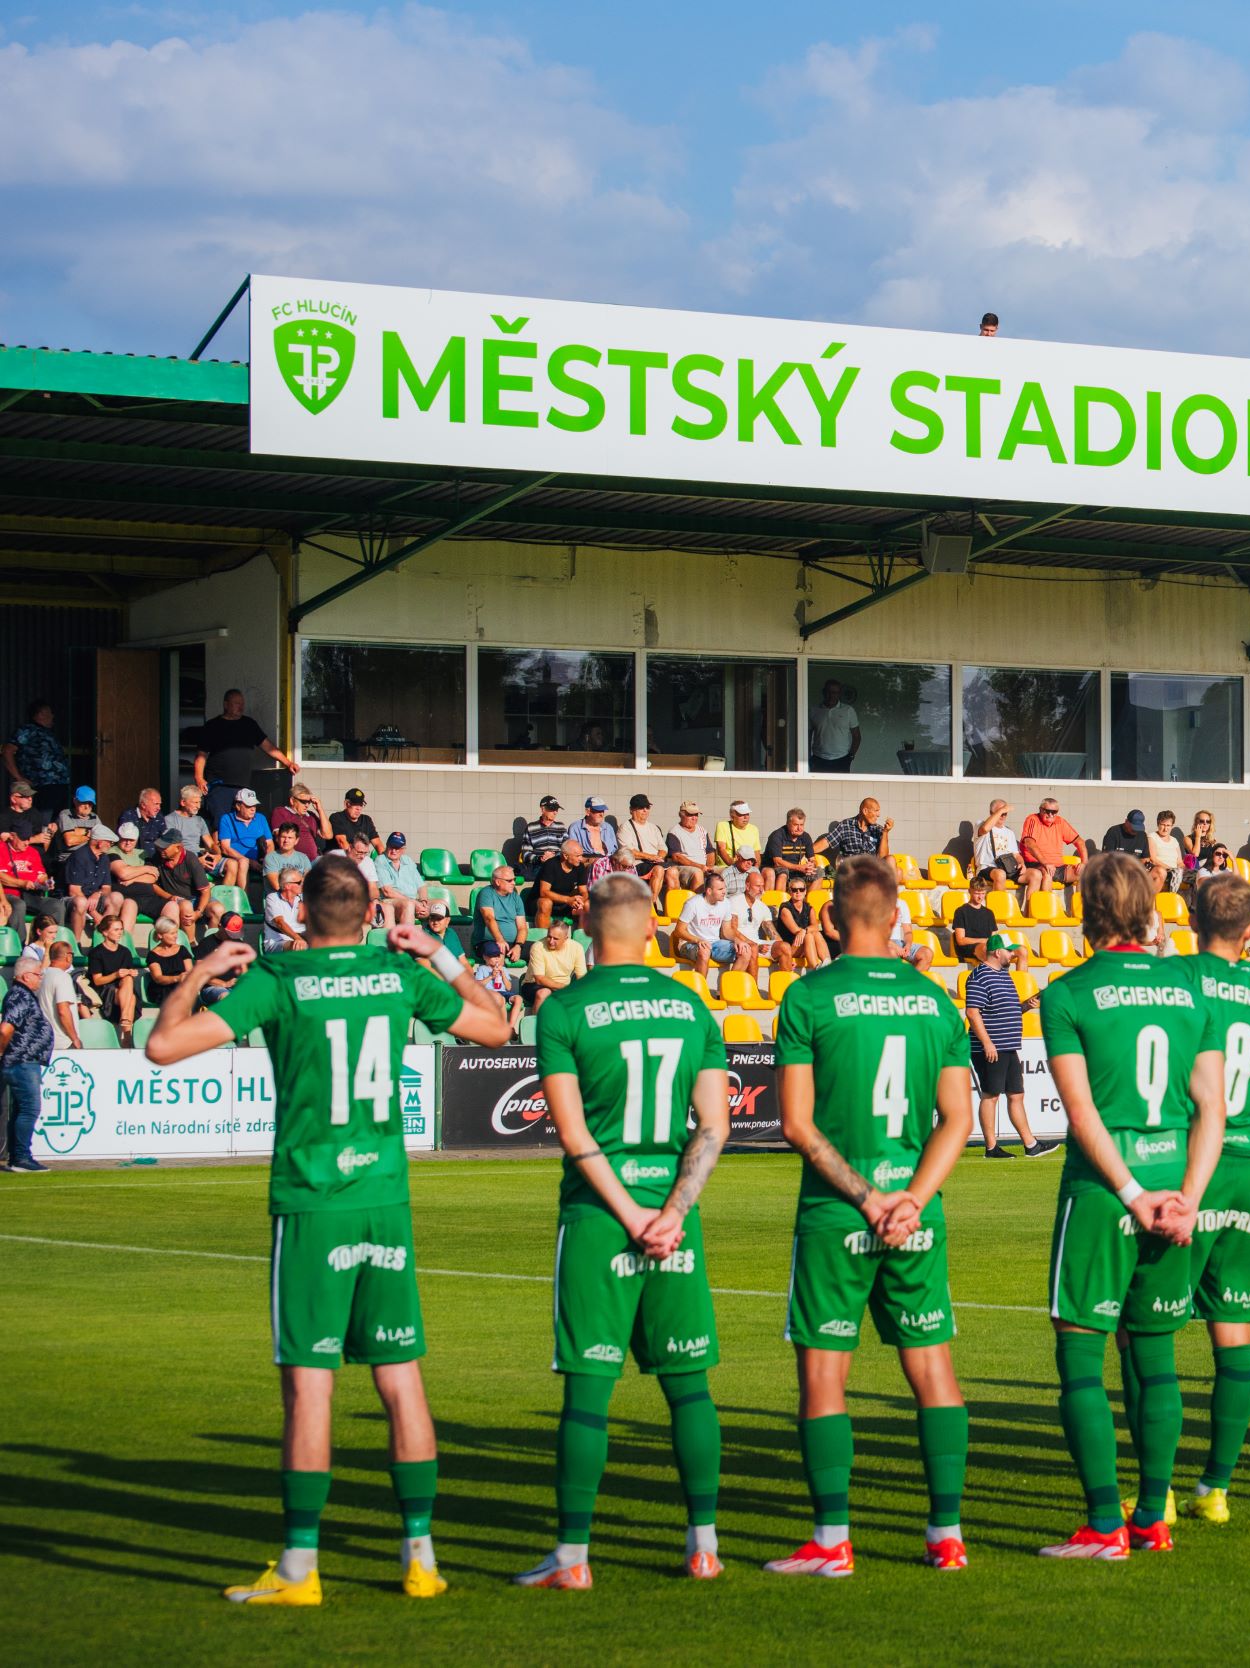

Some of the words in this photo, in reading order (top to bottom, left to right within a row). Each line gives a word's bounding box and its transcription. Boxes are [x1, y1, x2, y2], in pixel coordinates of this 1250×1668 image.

[271, 302, 293, 320] FC
[297, 299, 357, 326] HLUČÍN
[382, 315, 862, 448] MĚSTSKÝ
[319, 973, 403, 998] GIENGER
[1117, 986, 1195, 1009] GIENGER
[609, 998, 696, 1022] GIENGER
[858, 994, 940, 1017] GIENGER
[325, 1015, 394, 1125] 14
[459, 1057, 538, 1070] AUTOSERVIS
[1136, 1024, 1169, 1126] 9
[116, 1070, 223, 1105] MĚSTO
[237, 1077, 273, 1102] HL
[620, 1038, 684, 1144] 17
[872, 1035, 909, 1138] 4
[116, 1120, 145, 1135] člen
[151, 1119, 211, 1135] Národní
[215, 1118, 241, 1134] sítě
[911, 1309, 945, 1326] LAMA
